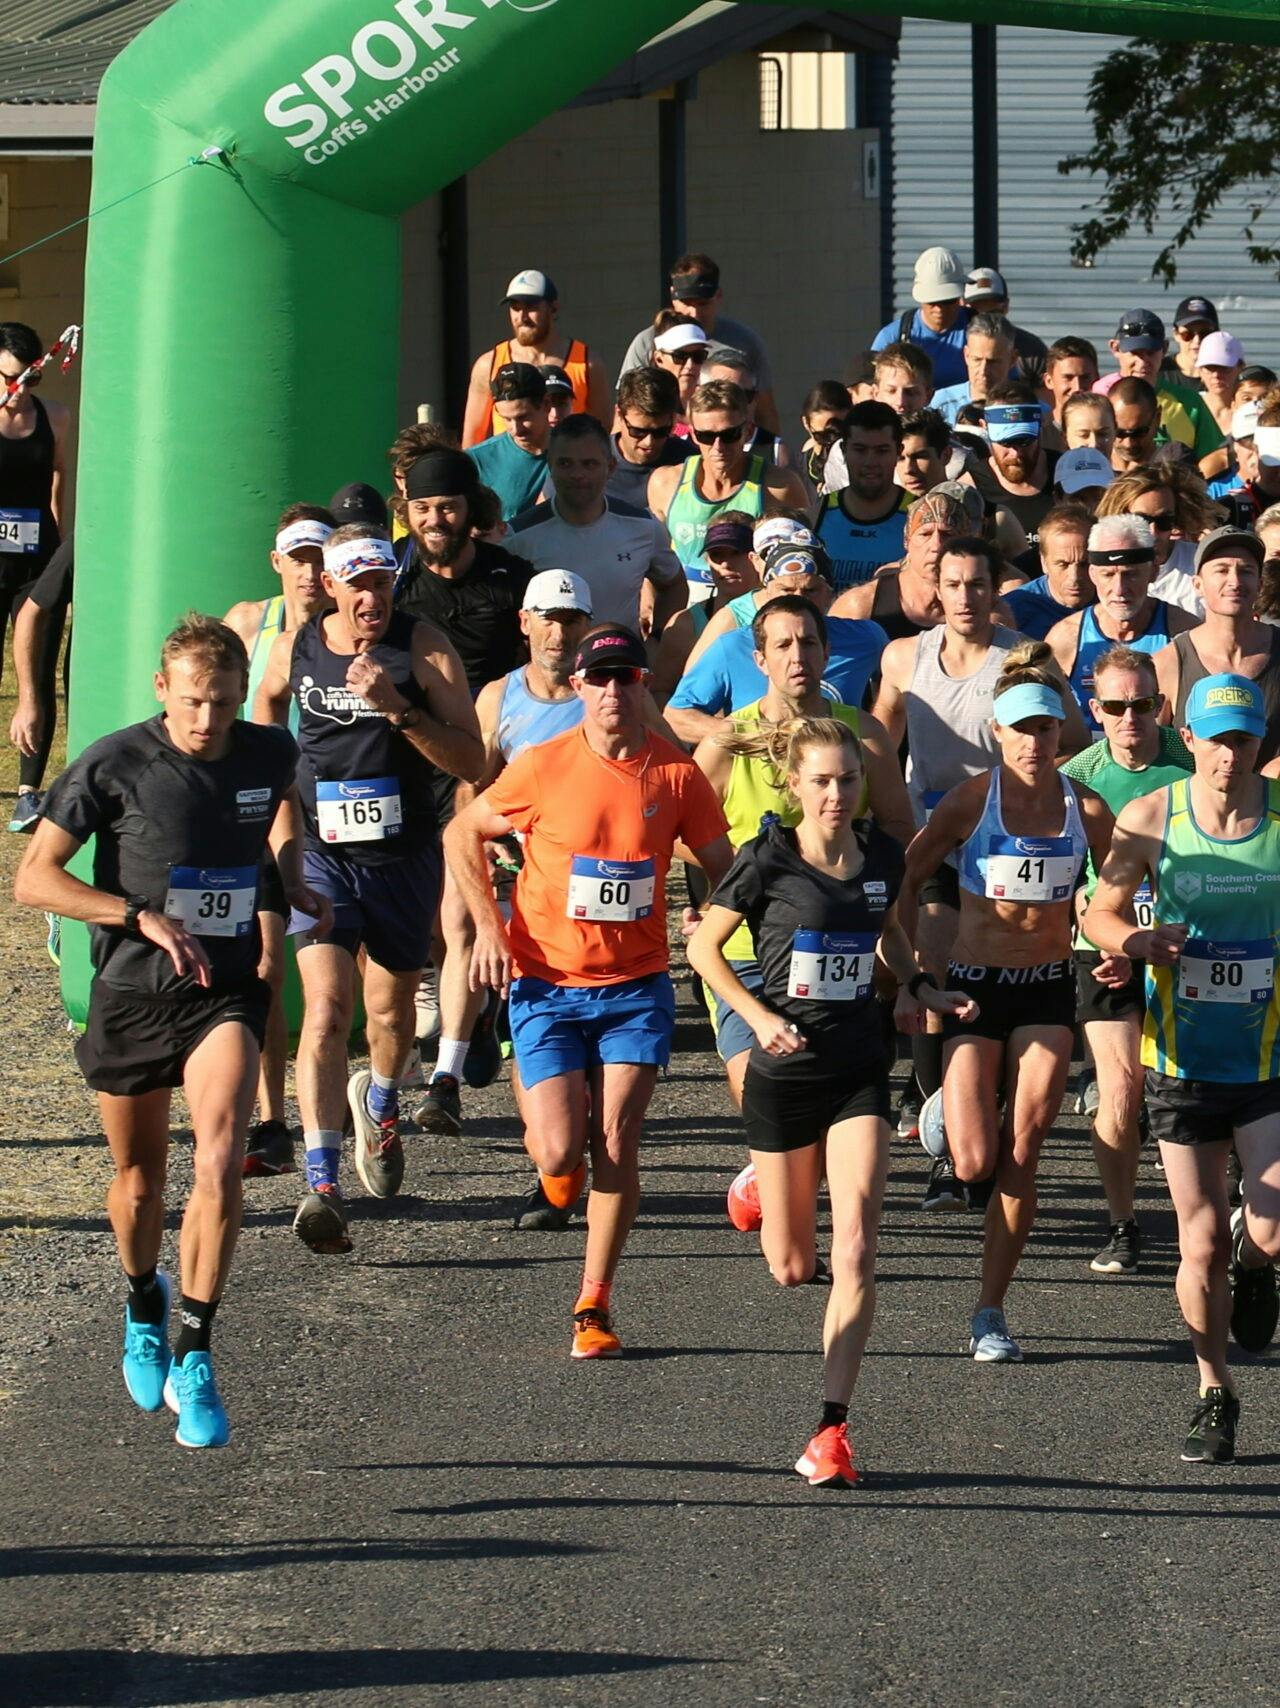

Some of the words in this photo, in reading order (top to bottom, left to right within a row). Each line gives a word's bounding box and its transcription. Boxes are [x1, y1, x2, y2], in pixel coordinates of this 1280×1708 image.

[263, 0, 502, 149] SPOR
[303, 116, 369, 165] Coffs
[364, 47, 462, 122] Harbour
[338, 800, 383, 826] 165
[1017, 858, 1046, 884] 41
[1205, 873, 1253, 884] Southern
[600, 880, 631, 906] 60
[1205, 884, 1259, 895] University
[198, 891, 232, 919] 39
[816, 955, 861, 982] 134
[997, 960, 1063, 984] NIKE
[1210, 961, 1243, 987] 80
[1256, 990, 1267, 999] 80
